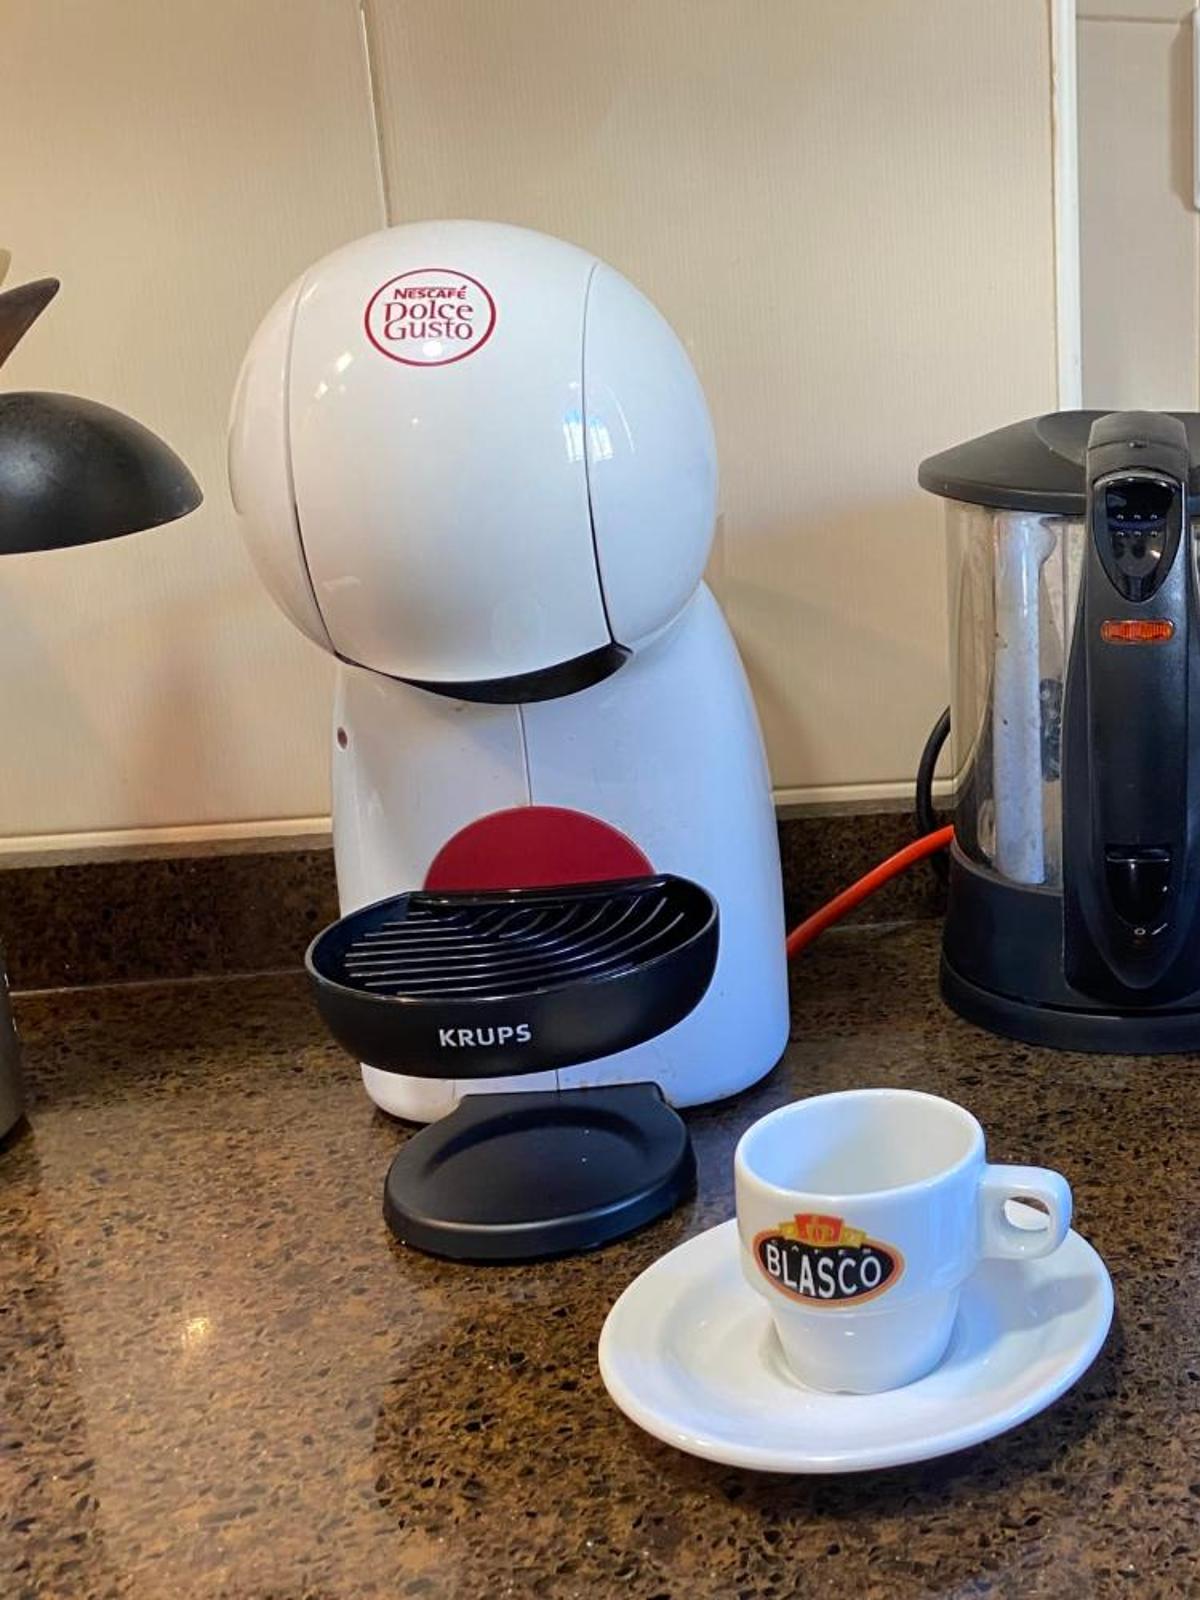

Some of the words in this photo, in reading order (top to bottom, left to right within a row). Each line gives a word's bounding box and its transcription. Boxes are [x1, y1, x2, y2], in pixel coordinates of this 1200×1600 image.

[394, 285, 467, 300] NESCAFÉ
[384, 300, 473, 321] Dolce
[384, 319, 473, 340] Gusto
[439, 1023, 532, 1047] KRUPS
[766, 1243, 882, 1298] BLASCO
